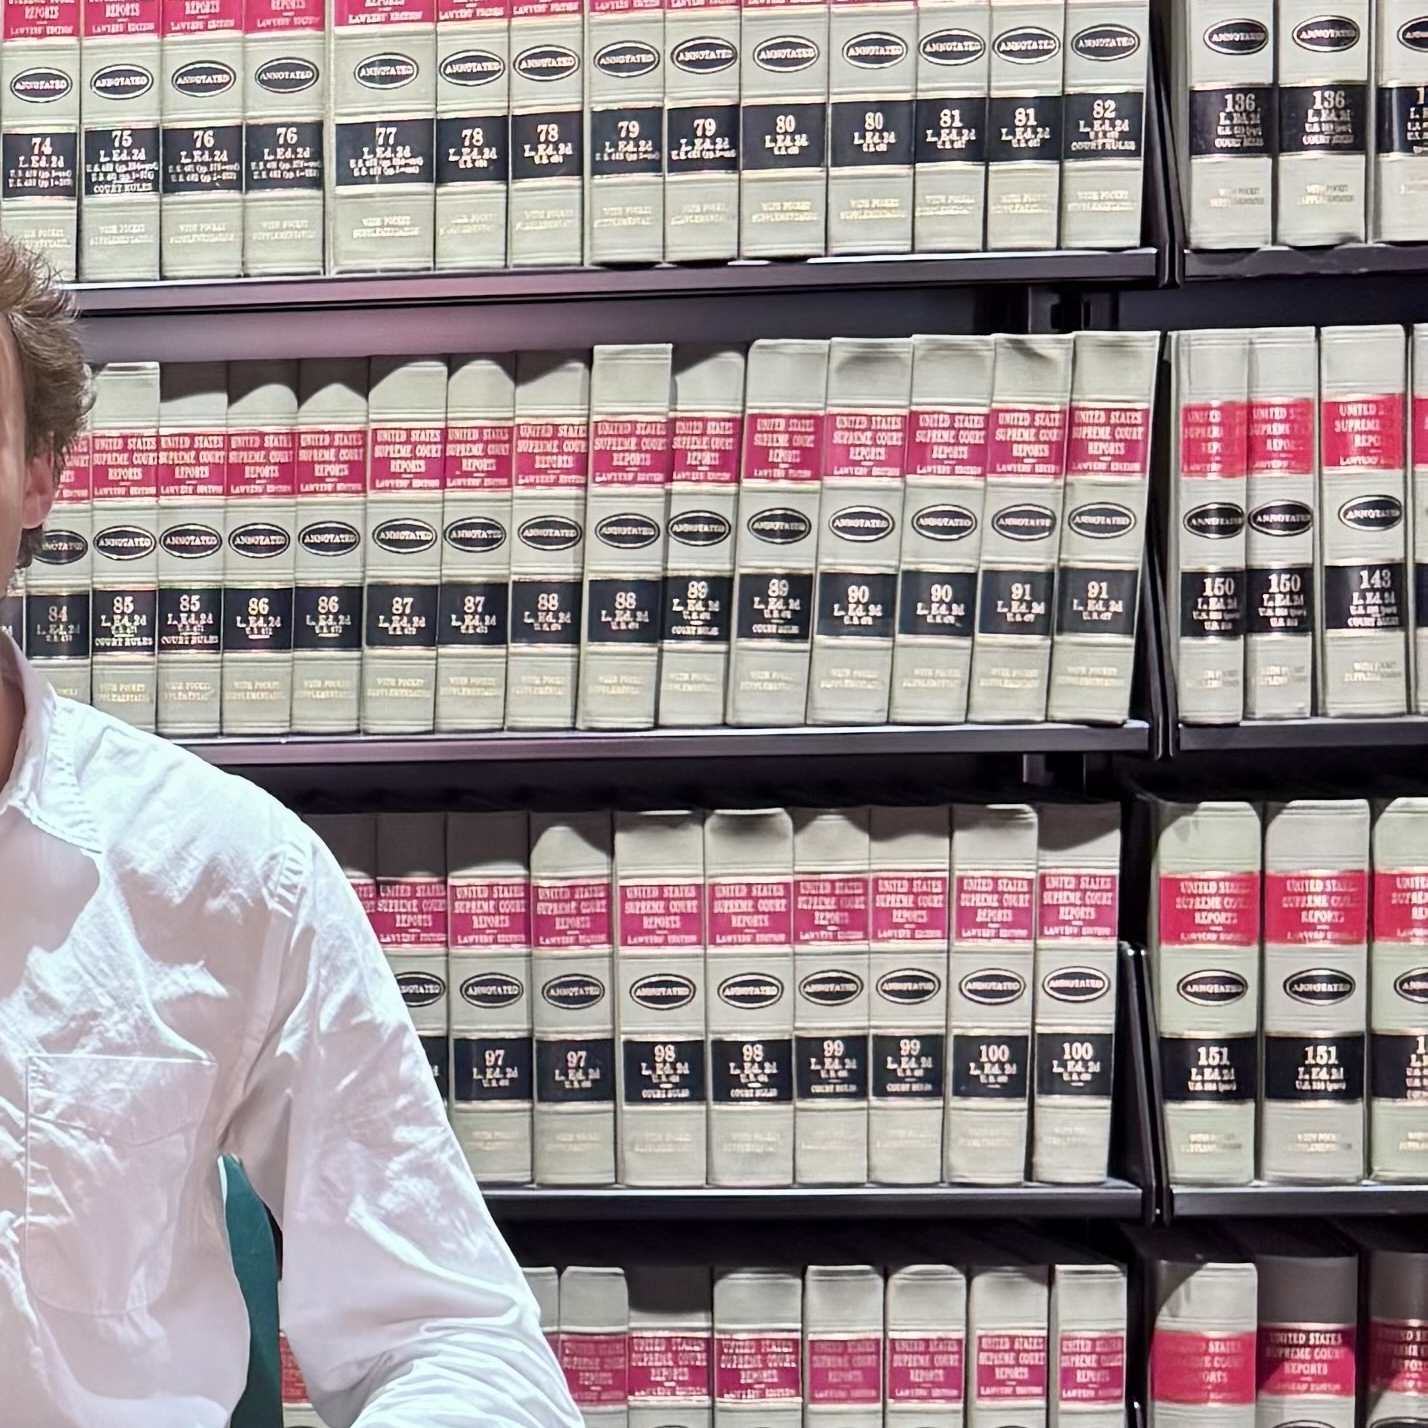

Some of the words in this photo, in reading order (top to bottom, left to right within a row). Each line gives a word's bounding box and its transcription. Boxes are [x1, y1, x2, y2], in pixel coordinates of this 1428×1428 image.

[939, 108, 964, 128] 81
[276, 126, 298, 145] 76
[617, 120, 640, 139] 79
[930, 583, 953, 603] 90
[1087, 580, 1109, 599] 91
[113, 595, 135, 614] 85
[317, 595, 339, 614] 86
[392, 597, 413, 615] 87
[899, 1038, 921, 1056] 99
[1062, 1041, 1094, 1060] 100
[1197, 1046, 1230, 1066] 151
[484, 1049, 505, 1067] 97
